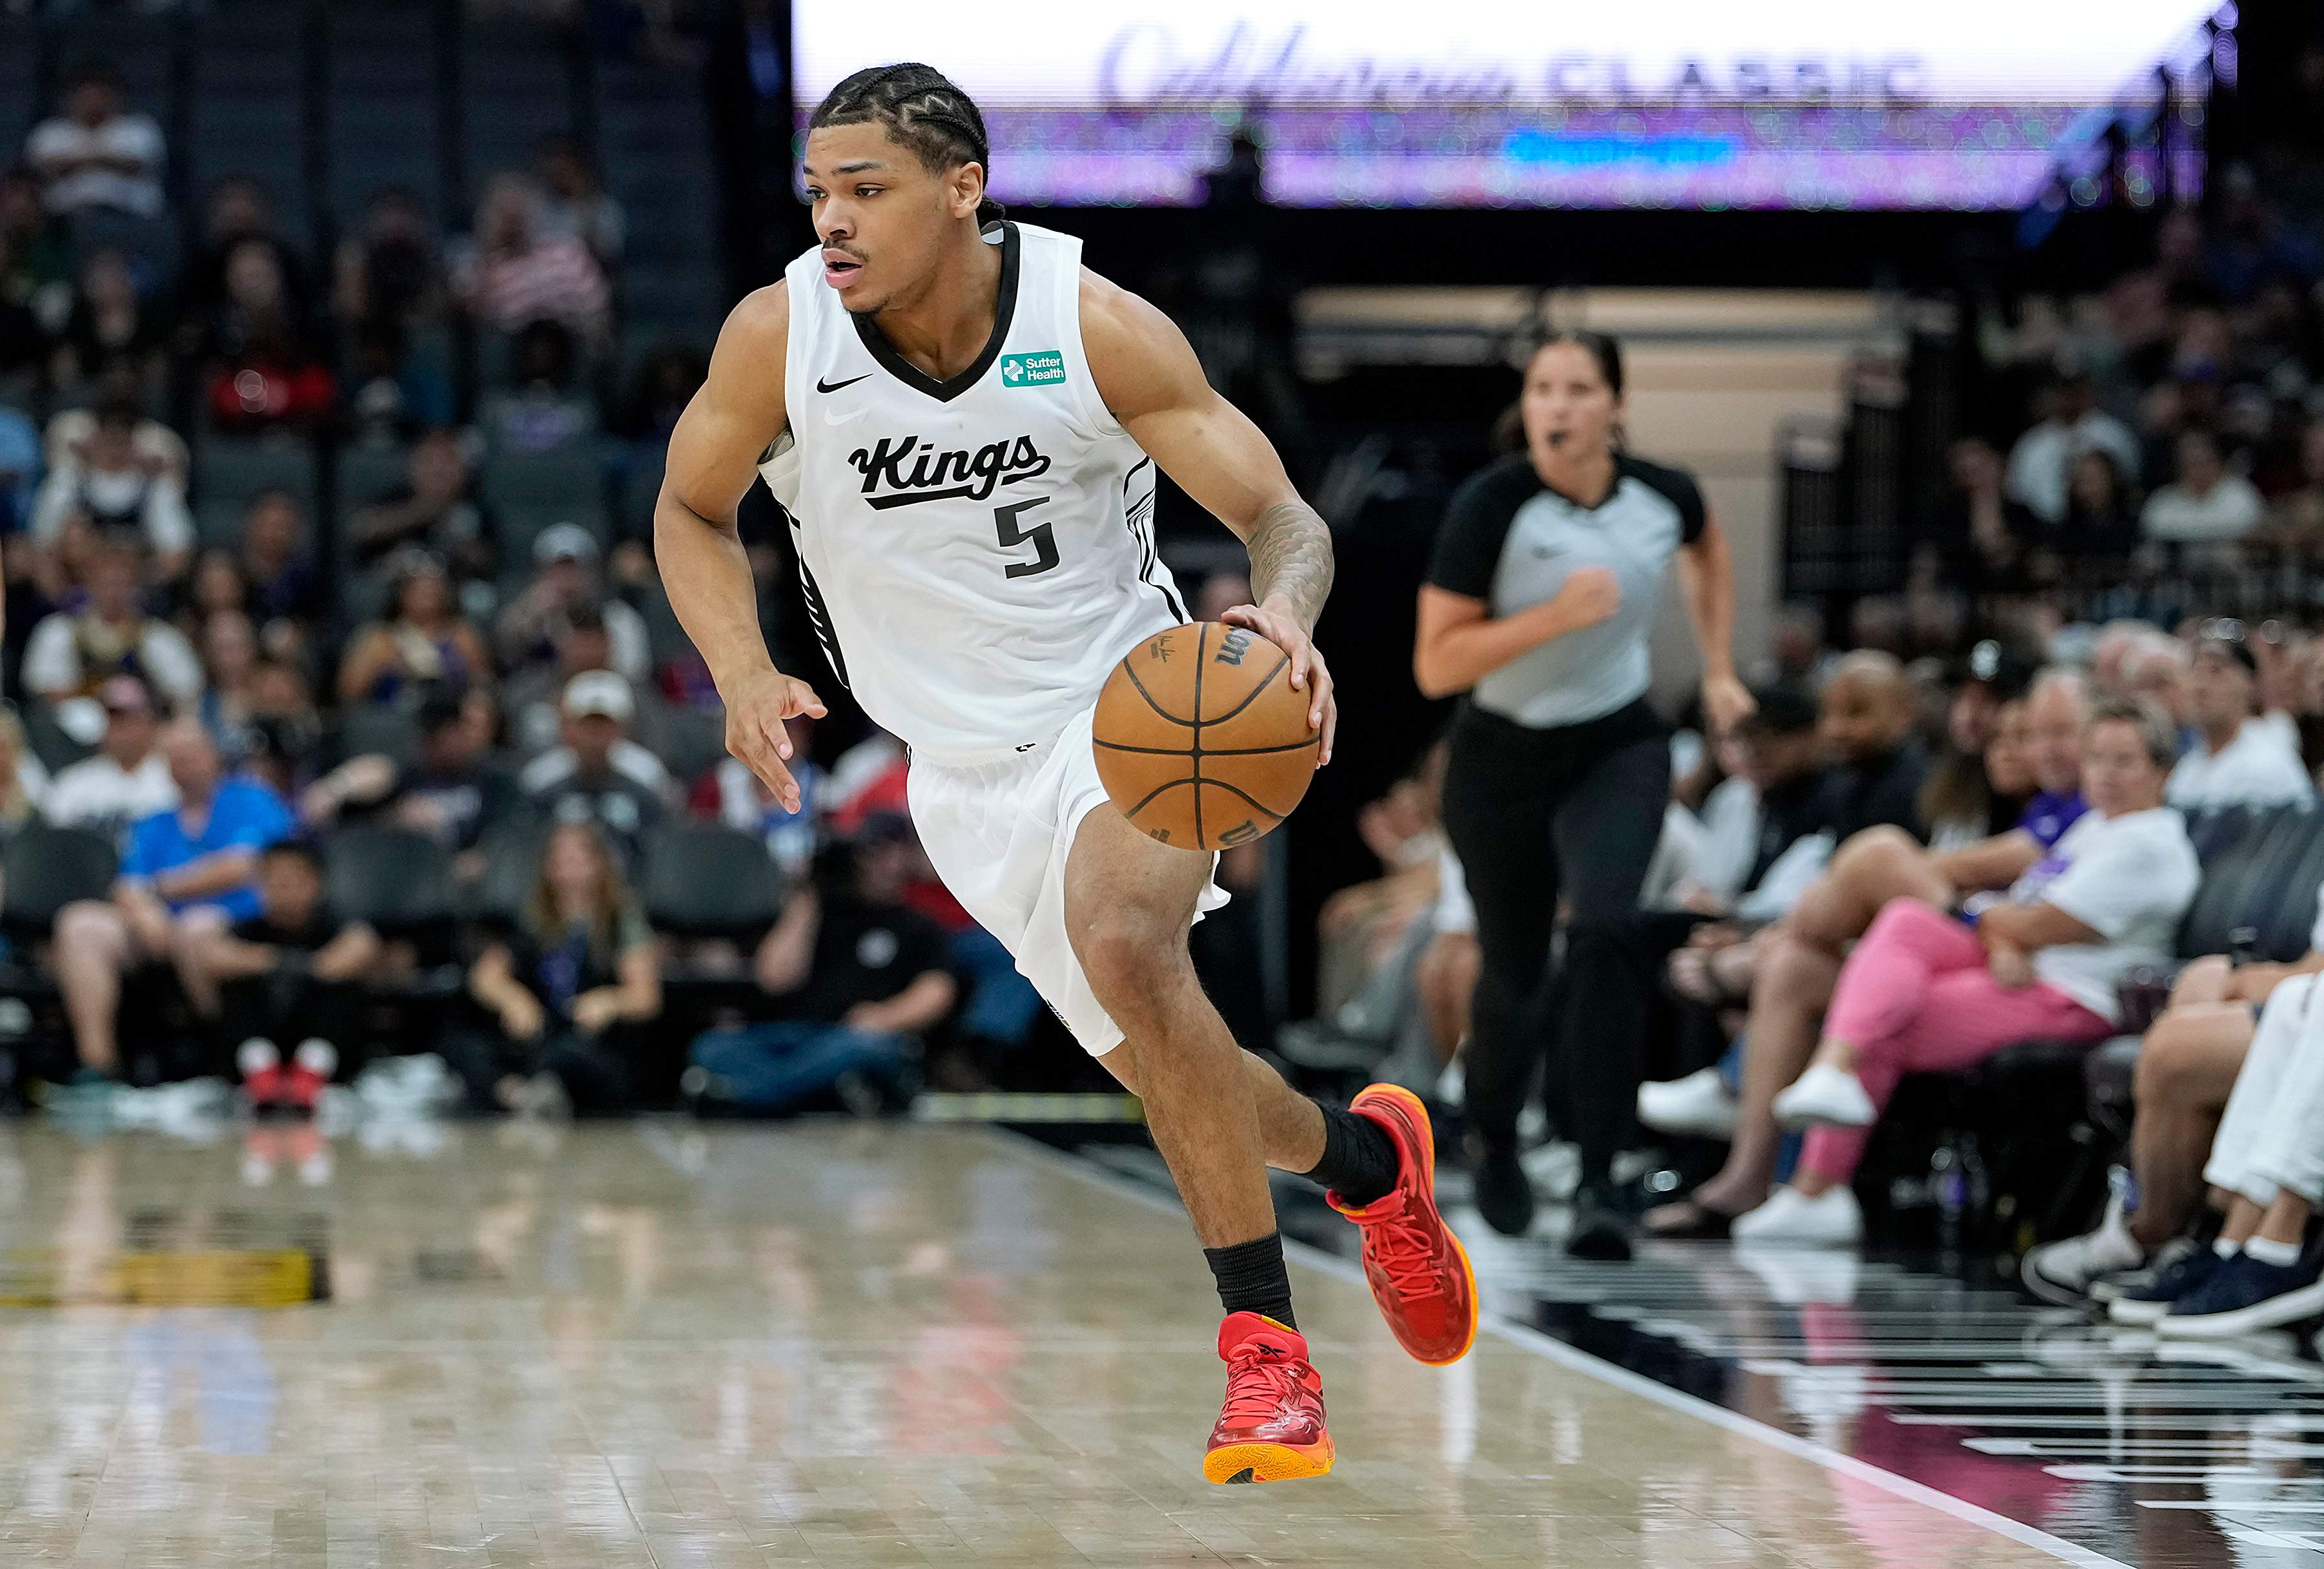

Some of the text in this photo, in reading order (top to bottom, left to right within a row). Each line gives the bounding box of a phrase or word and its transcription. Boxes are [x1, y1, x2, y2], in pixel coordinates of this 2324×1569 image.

[1026, 357, 1061, 369] Sutter
[1027, 368, 1064, 381] Health
[847, 435, 1052, 511] Kings
[994, 495, 1060, 579] 5
